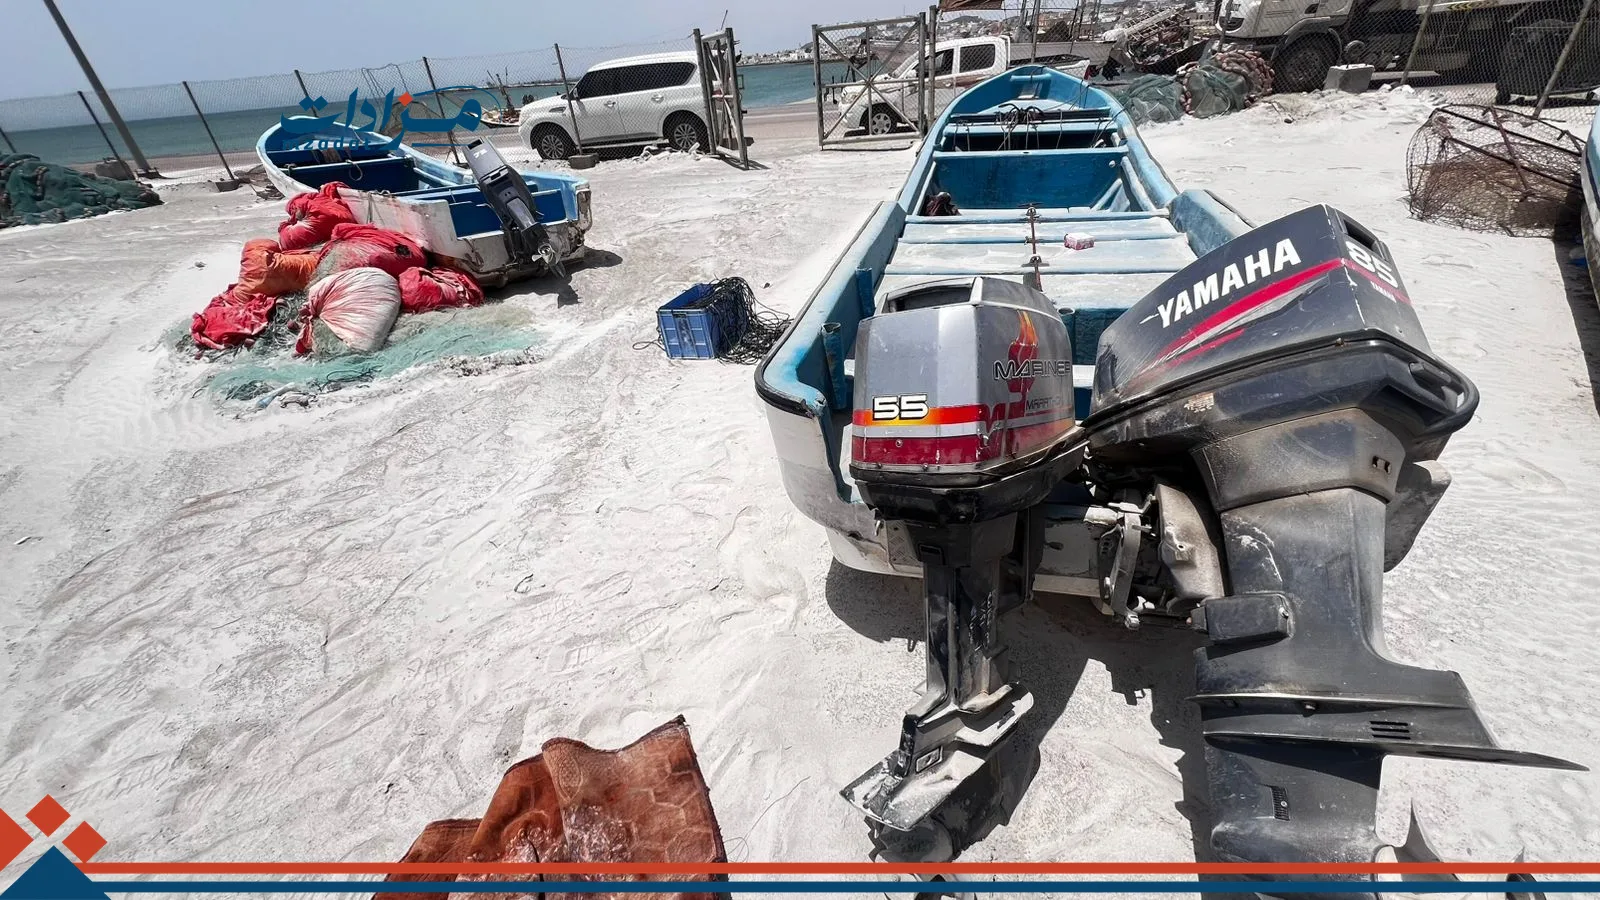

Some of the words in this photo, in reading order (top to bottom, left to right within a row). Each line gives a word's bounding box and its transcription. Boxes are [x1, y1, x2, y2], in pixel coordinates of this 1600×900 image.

[1345, 241, 1398, 288] 85
[1157, 238, 1302, 328] YAMAHA
[993, 359, 1071, 380] MARINER
[872, 394, 929, 420] 55
